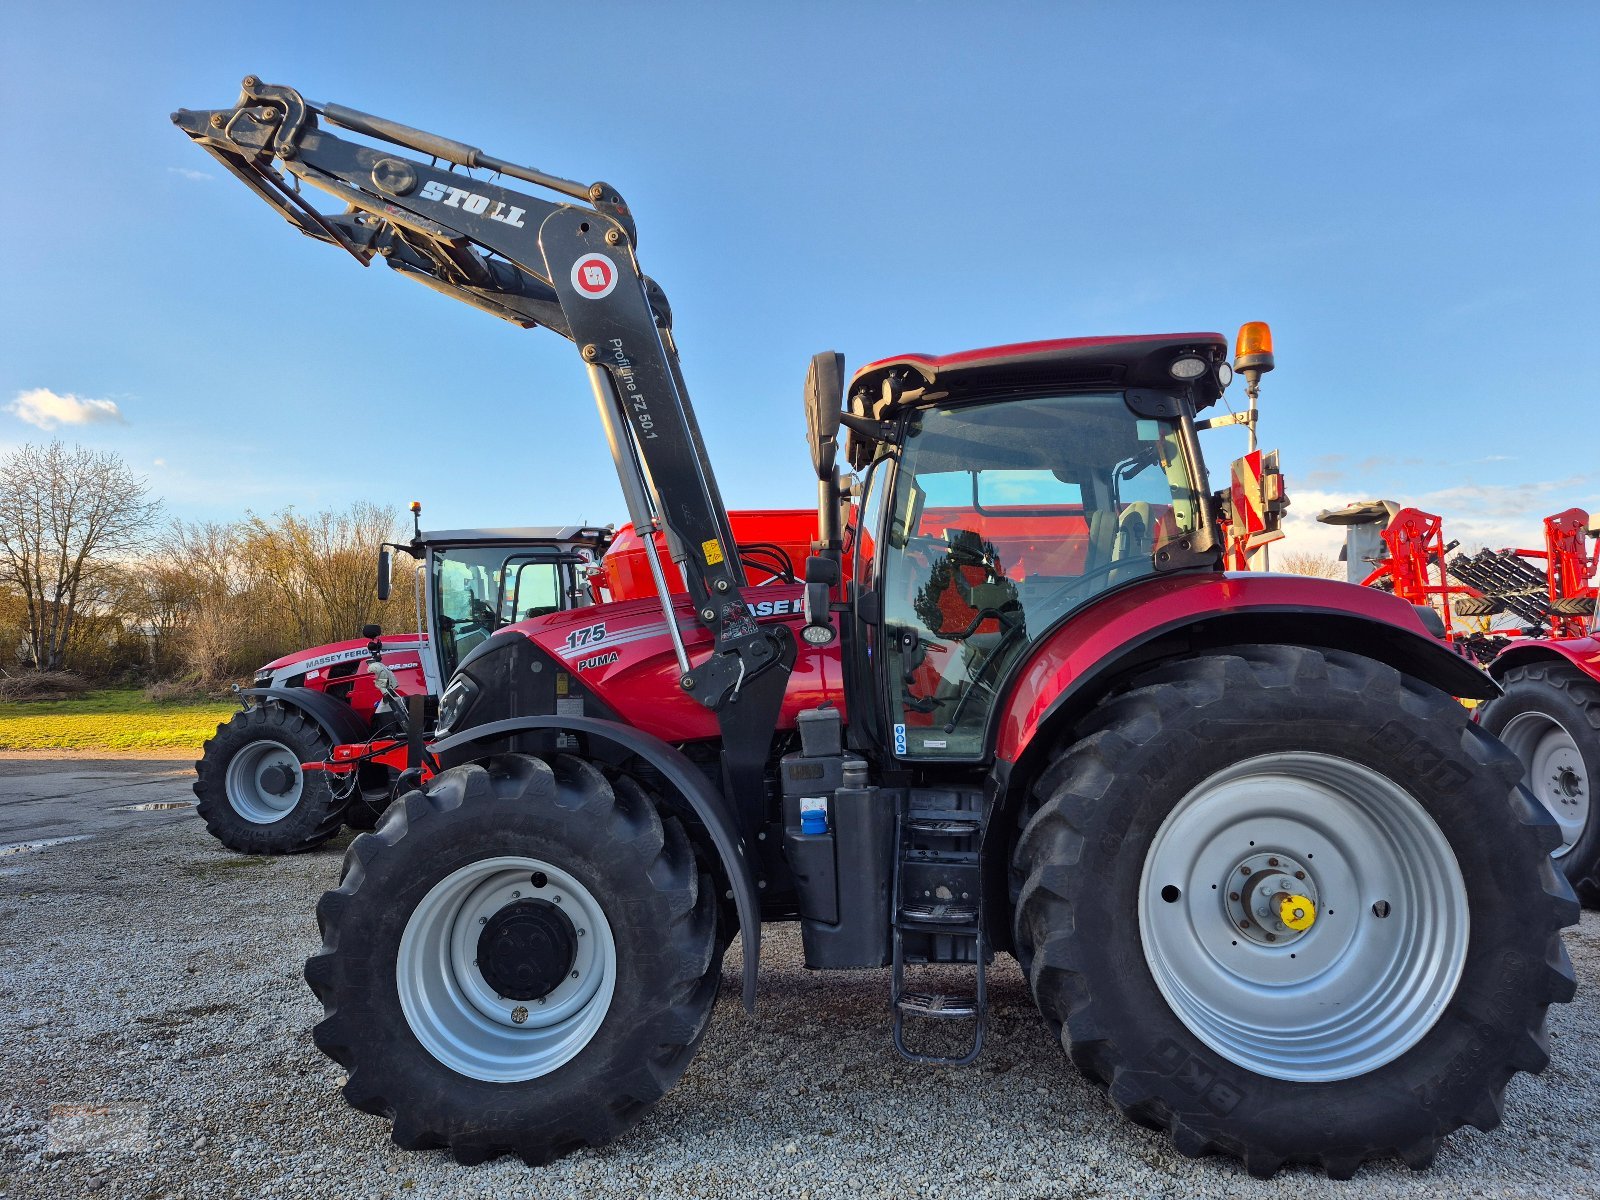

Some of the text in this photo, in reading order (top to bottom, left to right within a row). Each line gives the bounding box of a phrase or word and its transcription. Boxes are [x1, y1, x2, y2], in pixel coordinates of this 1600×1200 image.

[631, 394, 648, 412] FZ
[638, 413, 659, 439] 50.1
[566, 622, 607, 650] 175
[306, 653, 342, 669] MASSEY
[578, 651, 619, 672] PUMA
[1367, 719, 1474, 793] BKT
[1146, 1037, 1246, 1116] BKT
